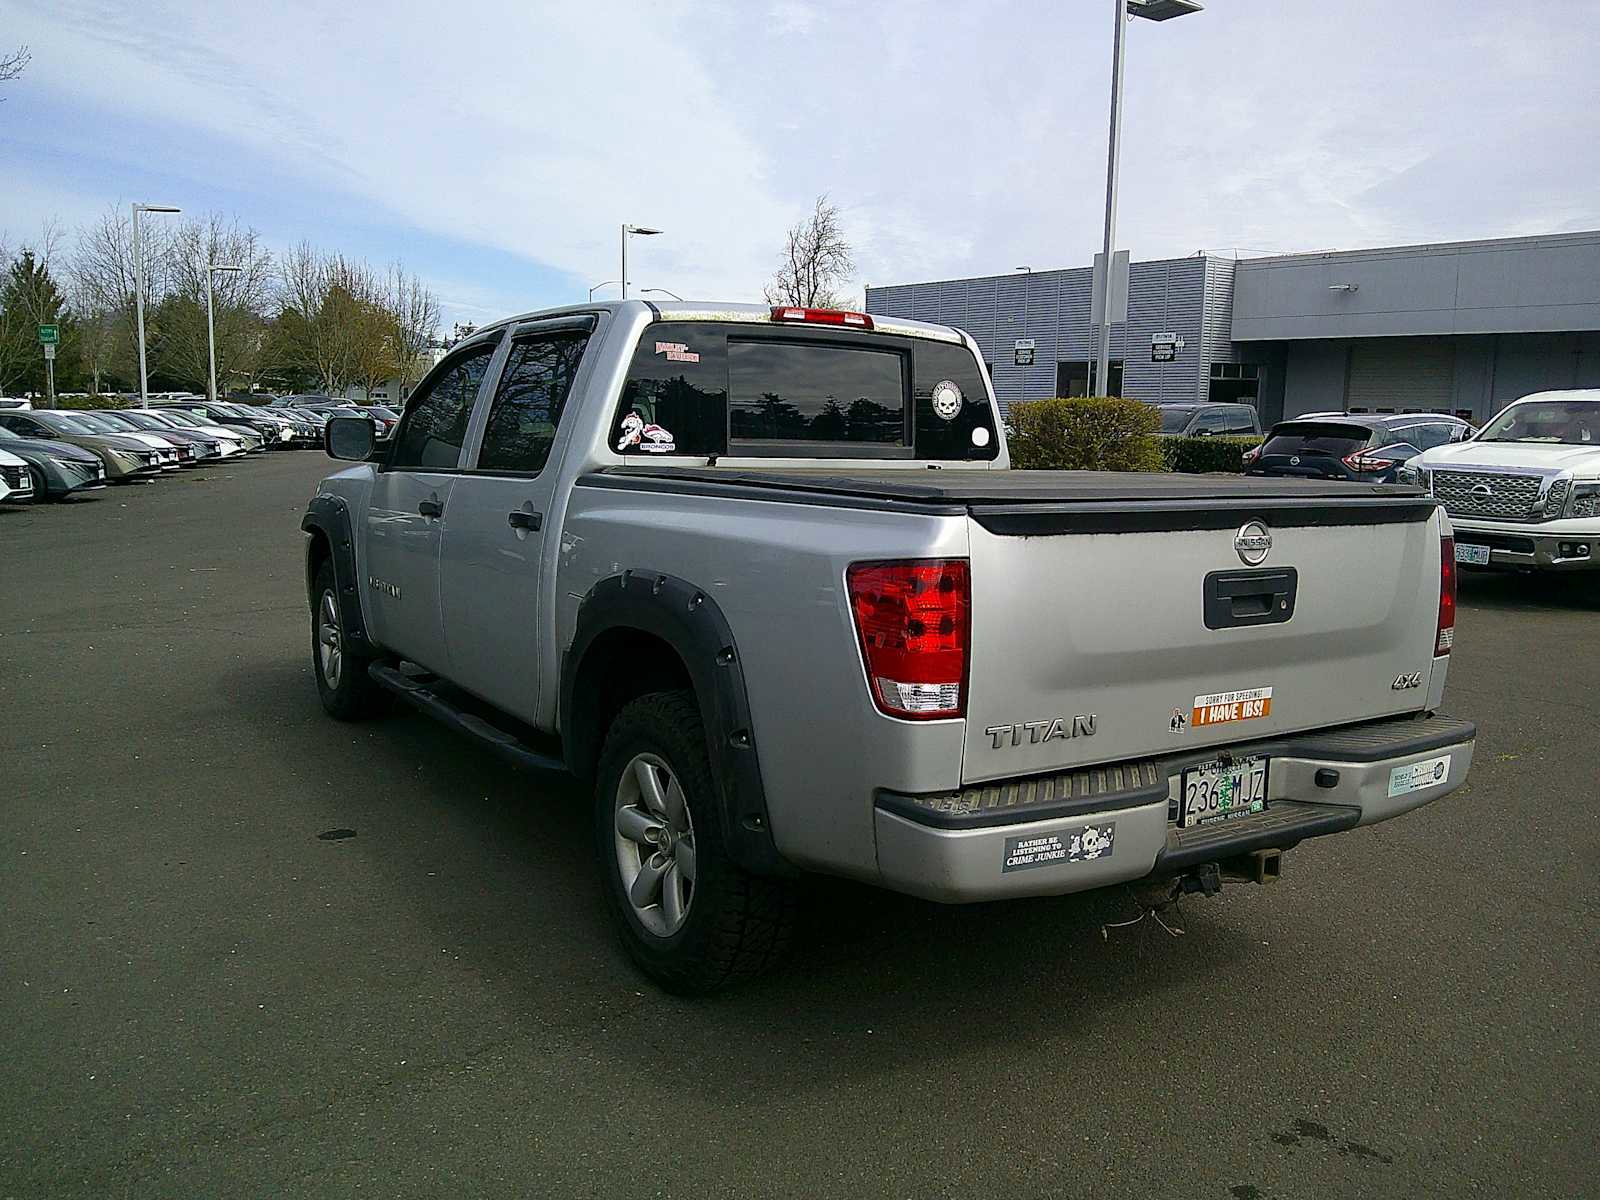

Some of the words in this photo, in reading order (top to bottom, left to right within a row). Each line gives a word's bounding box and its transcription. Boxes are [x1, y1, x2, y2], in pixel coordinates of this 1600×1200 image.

[1238, 538, 1270, 546] NISSAN
[1205, 695, 1223, 705] SORRY
[1224, 693, 1235, 702] FOR
[1236, 689, 1263, 701] SPEEDING!
[1200, 707, 1206, 724] I
[1209, 703, 1239, 723] HAVE
[1242, 699, 1265, 718] IBS!
[985, 714, 1097, 749] TITAN
[1186, 778, 1220, 815] 236
[1231, 769, 1264, 806] MJZ
[1227, 809, 1251, 819] NISSAN
[1012, 844, 1052, 857] LISTENING
[1052, 842, 1063, 851] TO
[1018, 838, 1048, 849] RATHER
[1048, 836, 1059, 844] BE
[1006, 855, 1035, 867] CRIME
[1035, 849, 1067, 863] JUNKIE
